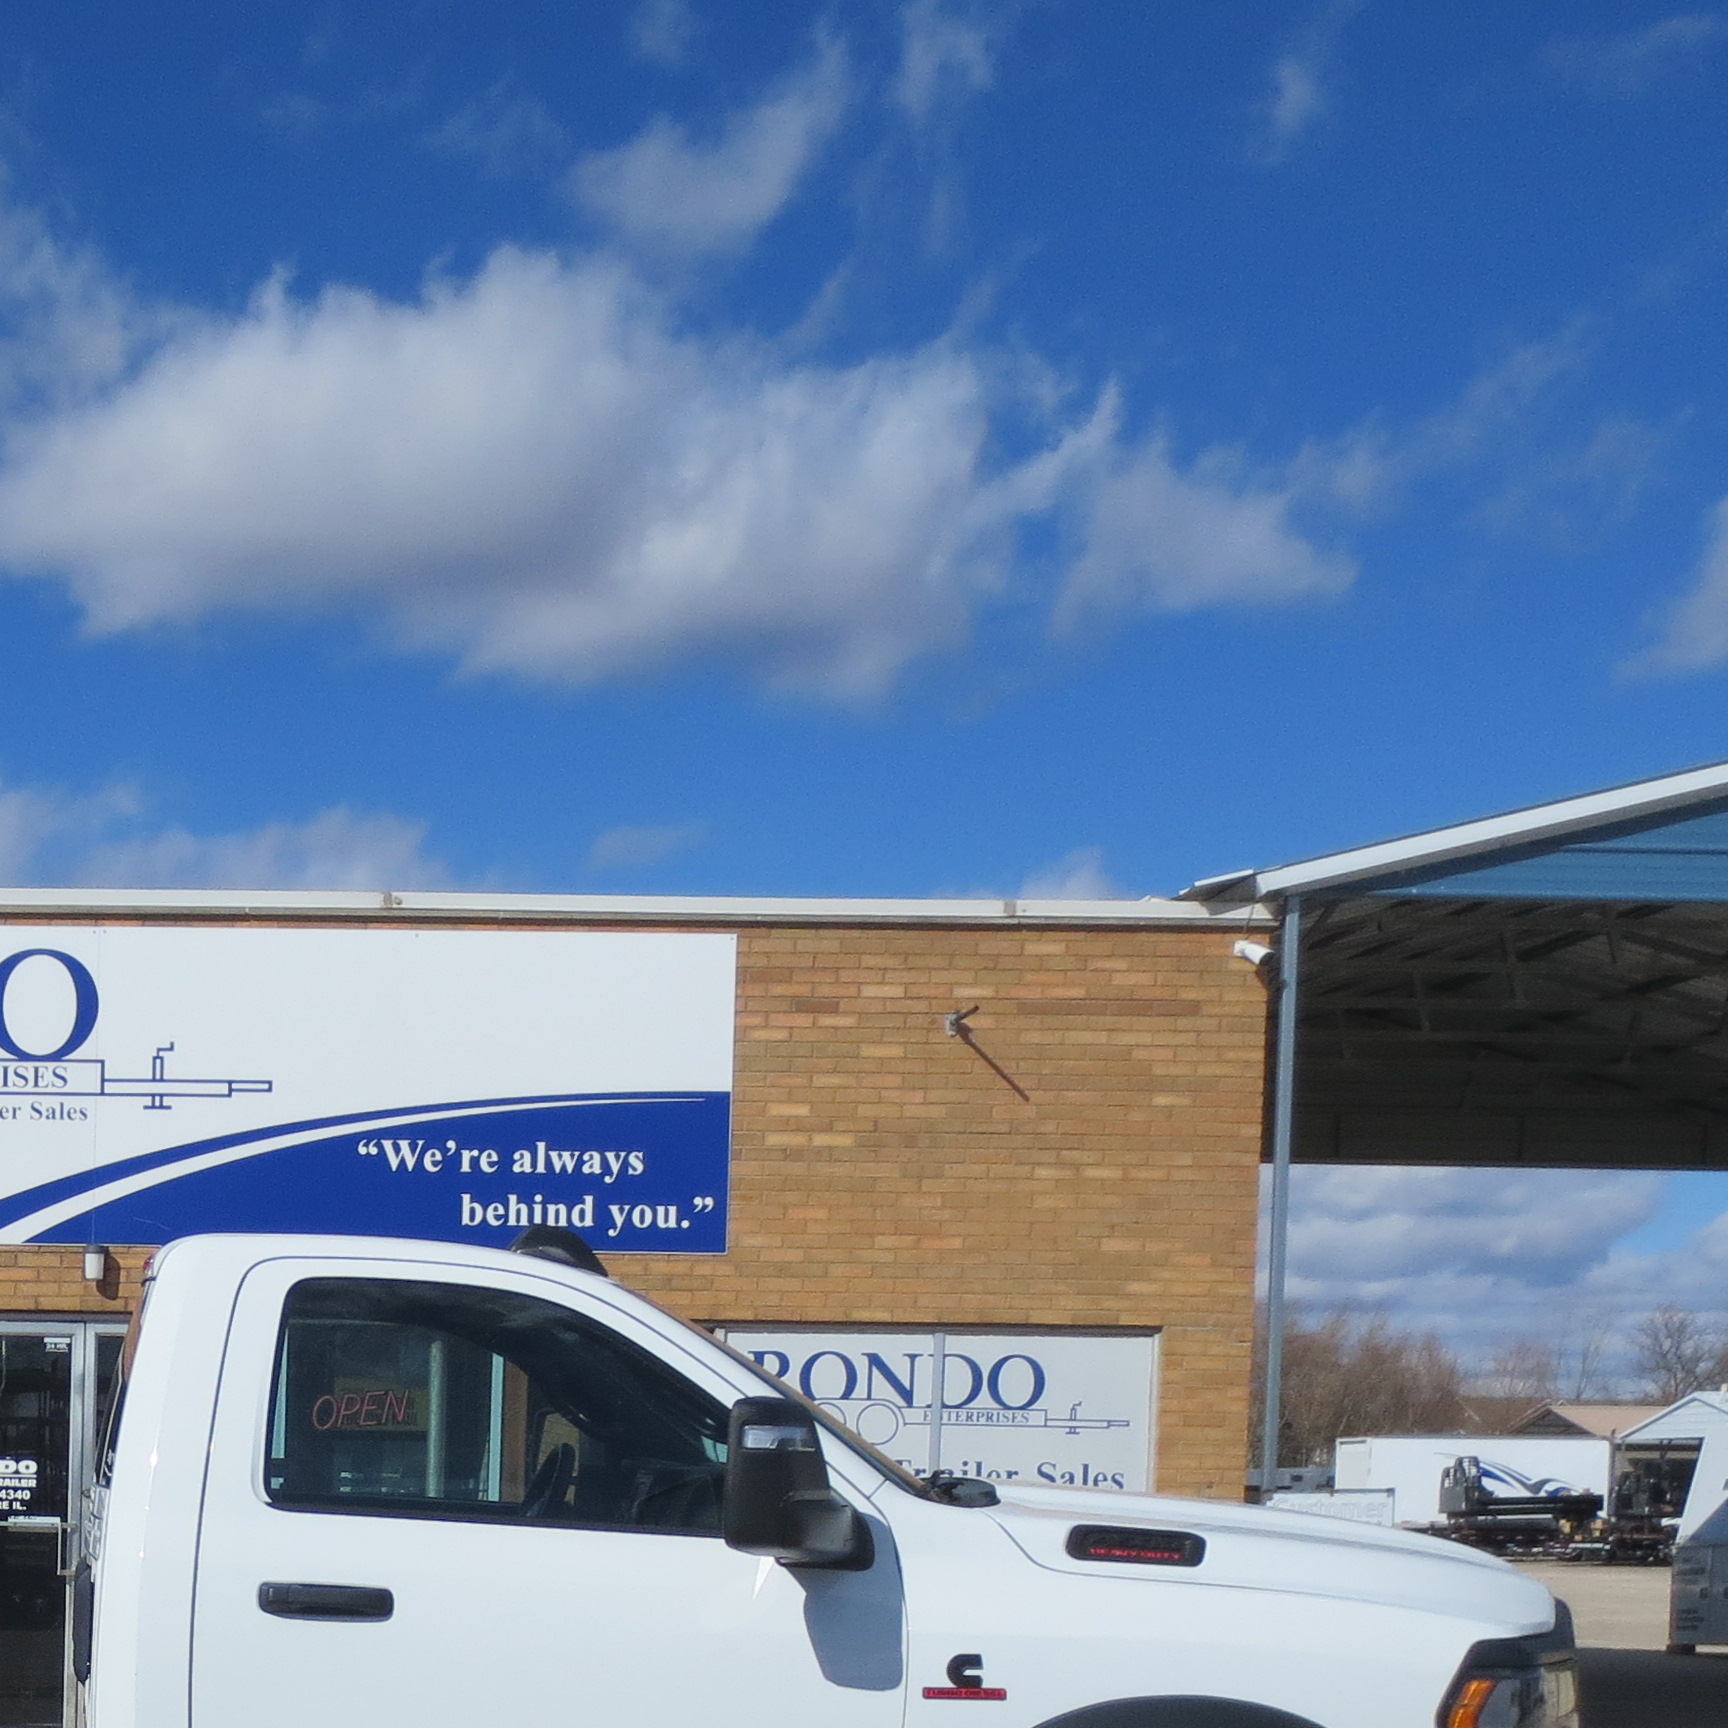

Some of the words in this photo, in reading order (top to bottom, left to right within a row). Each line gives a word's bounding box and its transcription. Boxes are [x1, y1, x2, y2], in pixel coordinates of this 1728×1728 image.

[29, 1101, 89, 1122] Sales
[511, 1141, 645, 1184] always
[460, 1193, 595, 1228] behind
[312, 1389, 409, 1430] OPEN
[922, 1410, 1031, 1424] ETERPRISES
